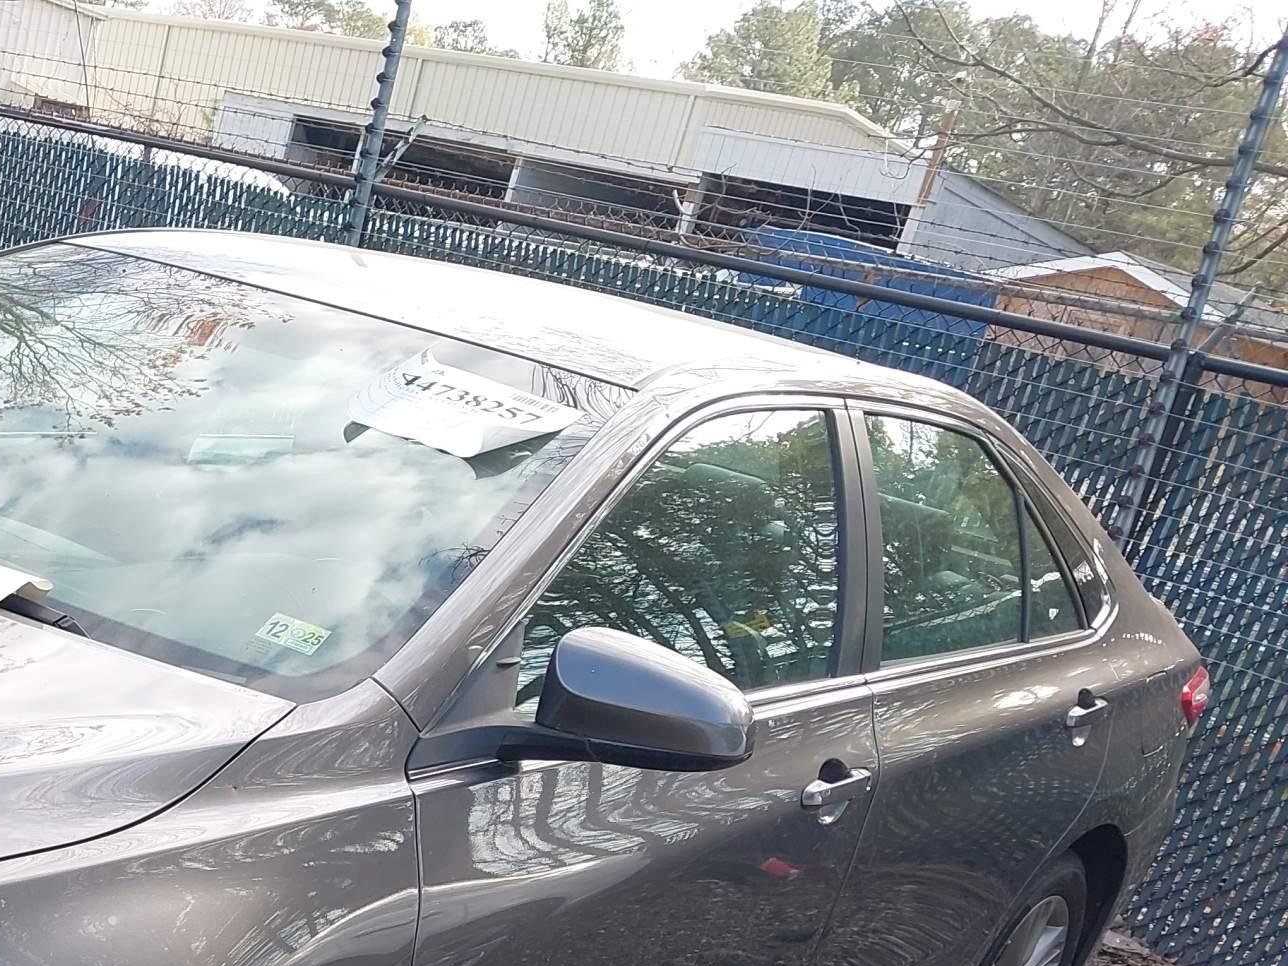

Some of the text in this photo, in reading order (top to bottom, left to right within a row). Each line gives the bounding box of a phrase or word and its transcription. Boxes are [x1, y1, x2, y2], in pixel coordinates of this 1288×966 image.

[402, 372, 542, 424] 44738257
[265, 620, 289, 639] 12
[301, 631, 324, 646] 25
